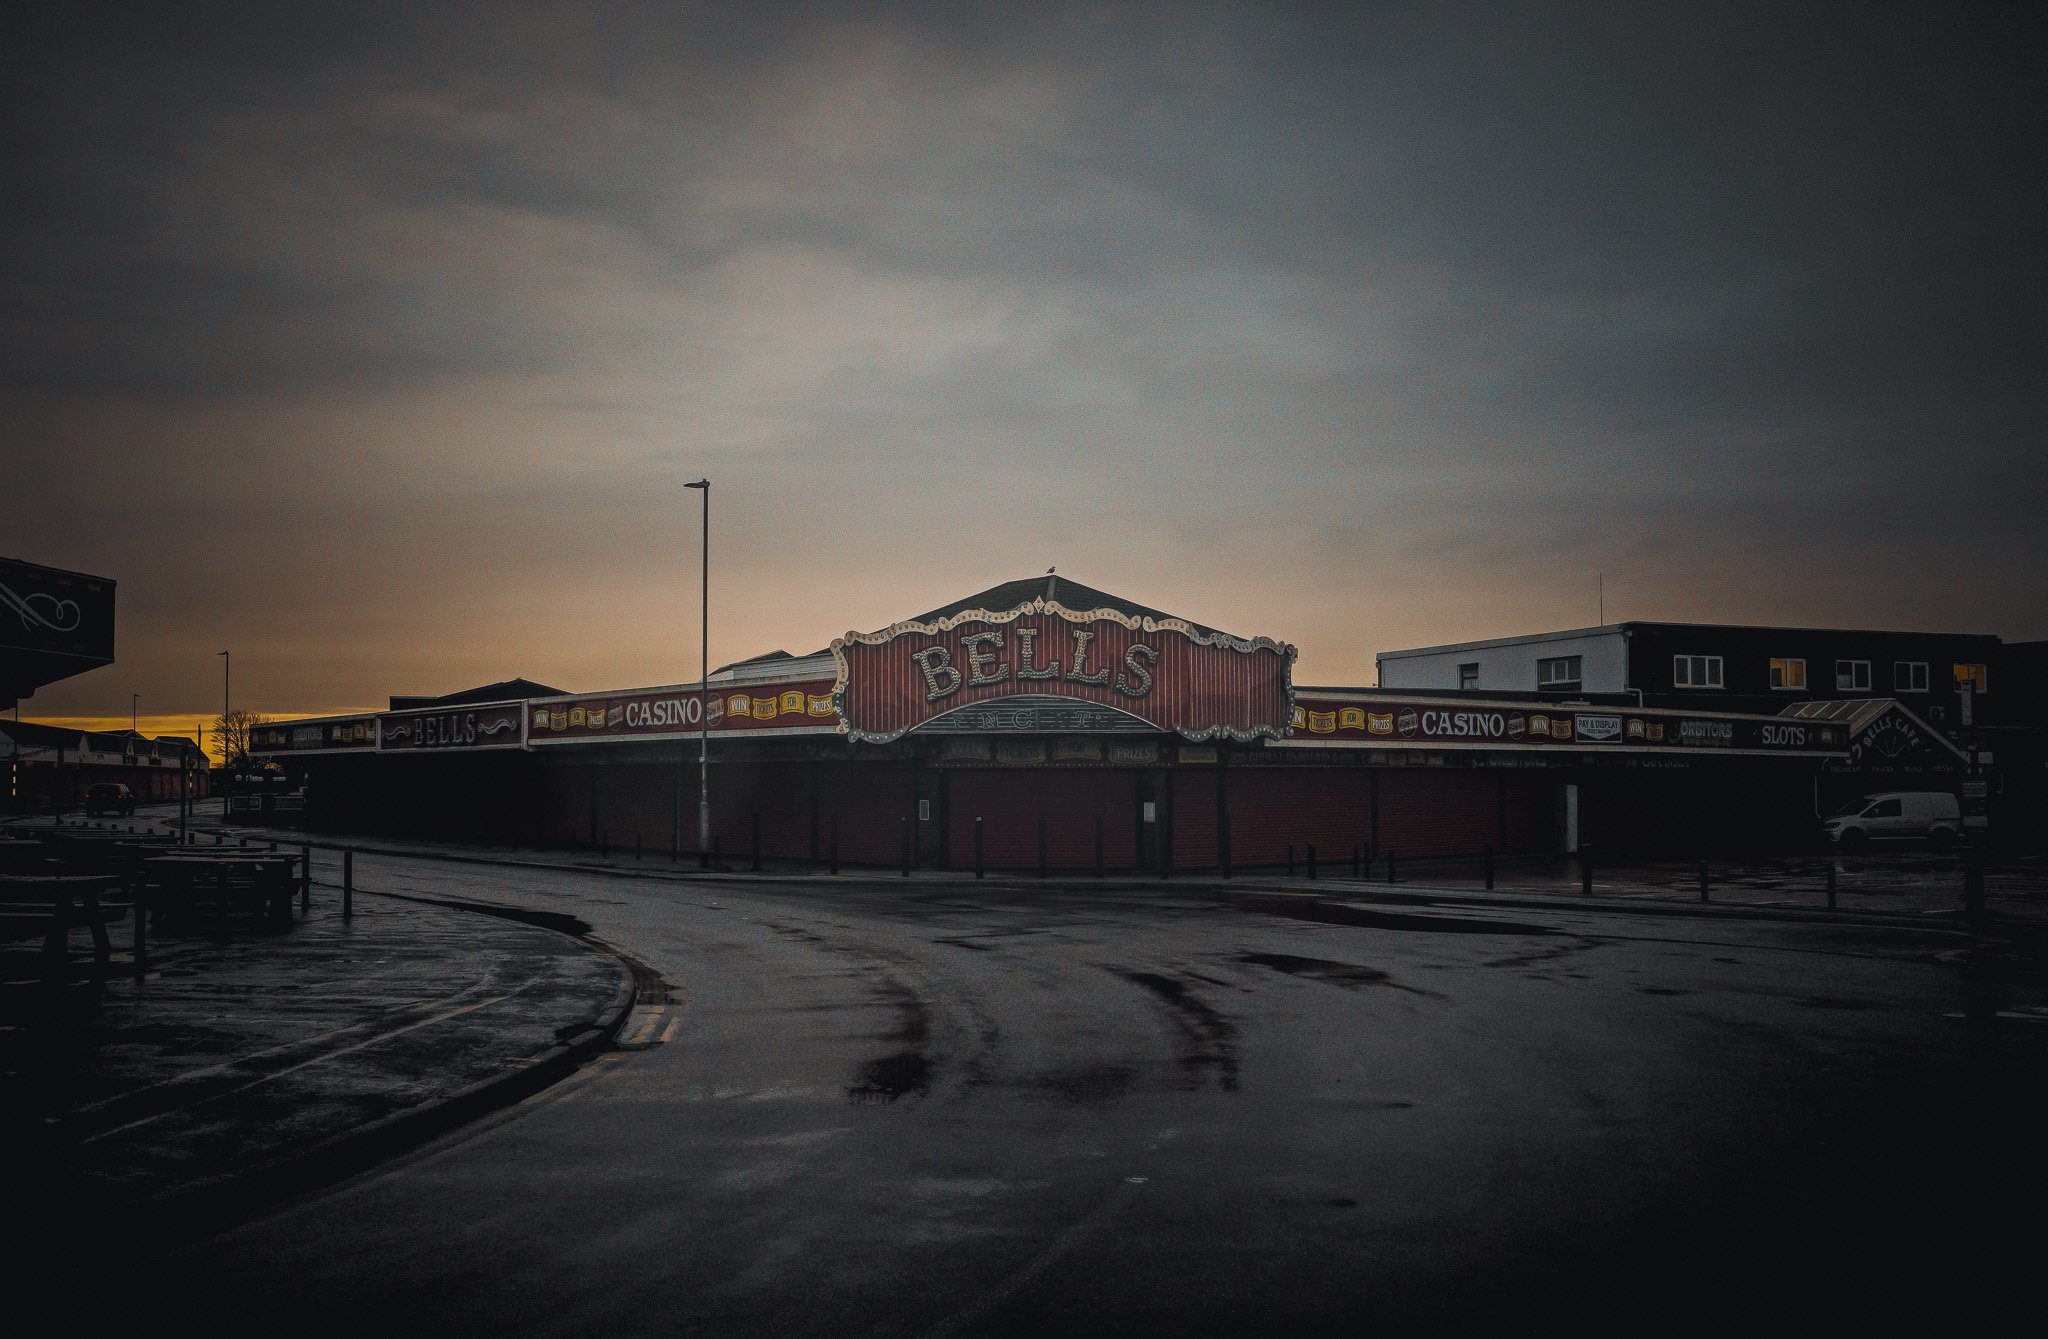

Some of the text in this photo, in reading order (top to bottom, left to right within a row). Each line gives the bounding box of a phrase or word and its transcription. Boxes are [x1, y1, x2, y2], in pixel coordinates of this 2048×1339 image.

[911, 628, 1160, 703] BELLS
[626, 697, 702, 727] CASINO
[731, 700, 746, 712] WIN
[811, 700, 830, 712] PRIZES
[414, 714, 475, 745] BELLS
[1372, 719, 1389, 730] PRIZES
[1422, 711, 1505, 737] CASINO
[1532, 719, 1547, 730] WIN
[1578, 719, 1618, 729] PAY & DISPLAY
[1680, 720, 1733, 738] ORBITORS
[1862, 716, 1920, 747] BELLS CAFE
[1762, 725, 1805, 745] SLOTS
[1117, 746, 1151, 759] PRIZES
